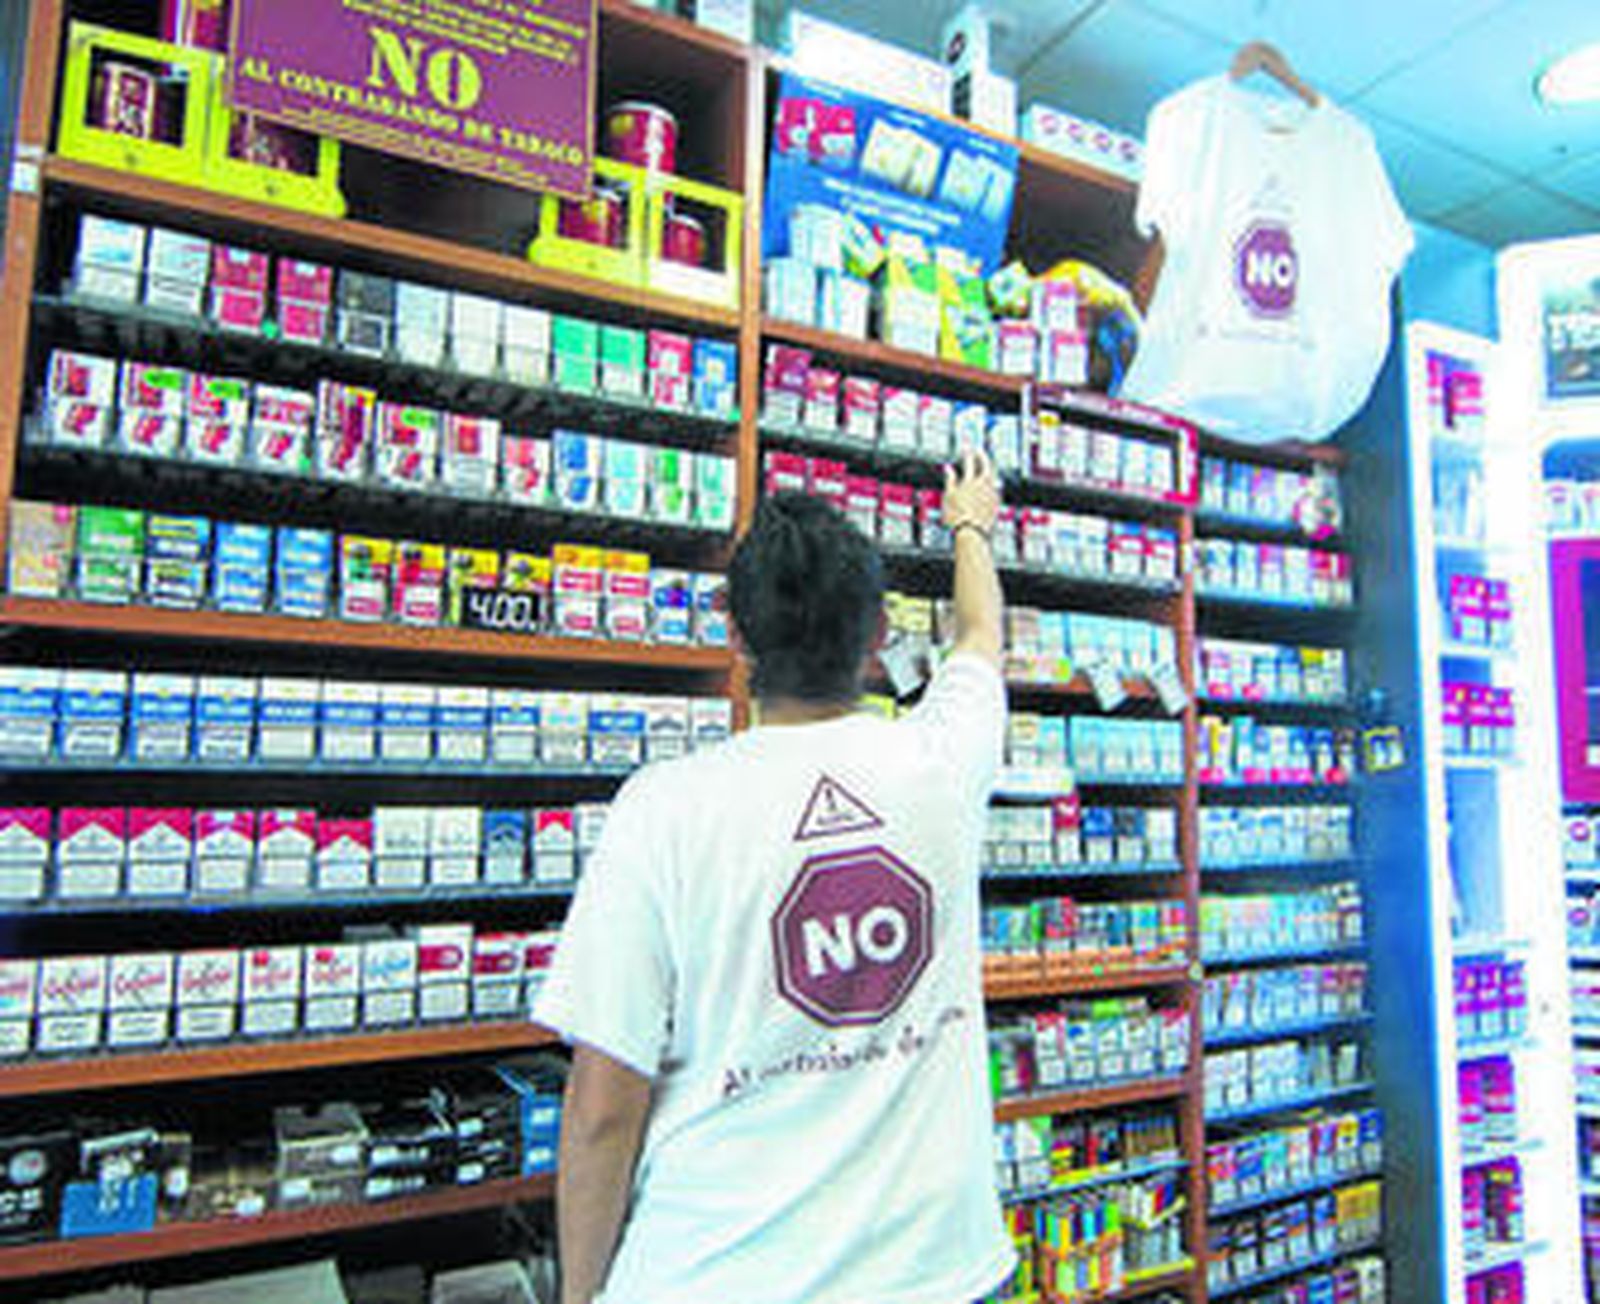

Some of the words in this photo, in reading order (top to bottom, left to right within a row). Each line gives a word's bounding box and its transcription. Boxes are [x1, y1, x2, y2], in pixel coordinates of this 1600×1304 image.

[240, 57, 272, 83] AL
[366, 26, 482, 110] NO
[1248, 251, 1295, 287] NO
[801, 905, 908, 978] NO
